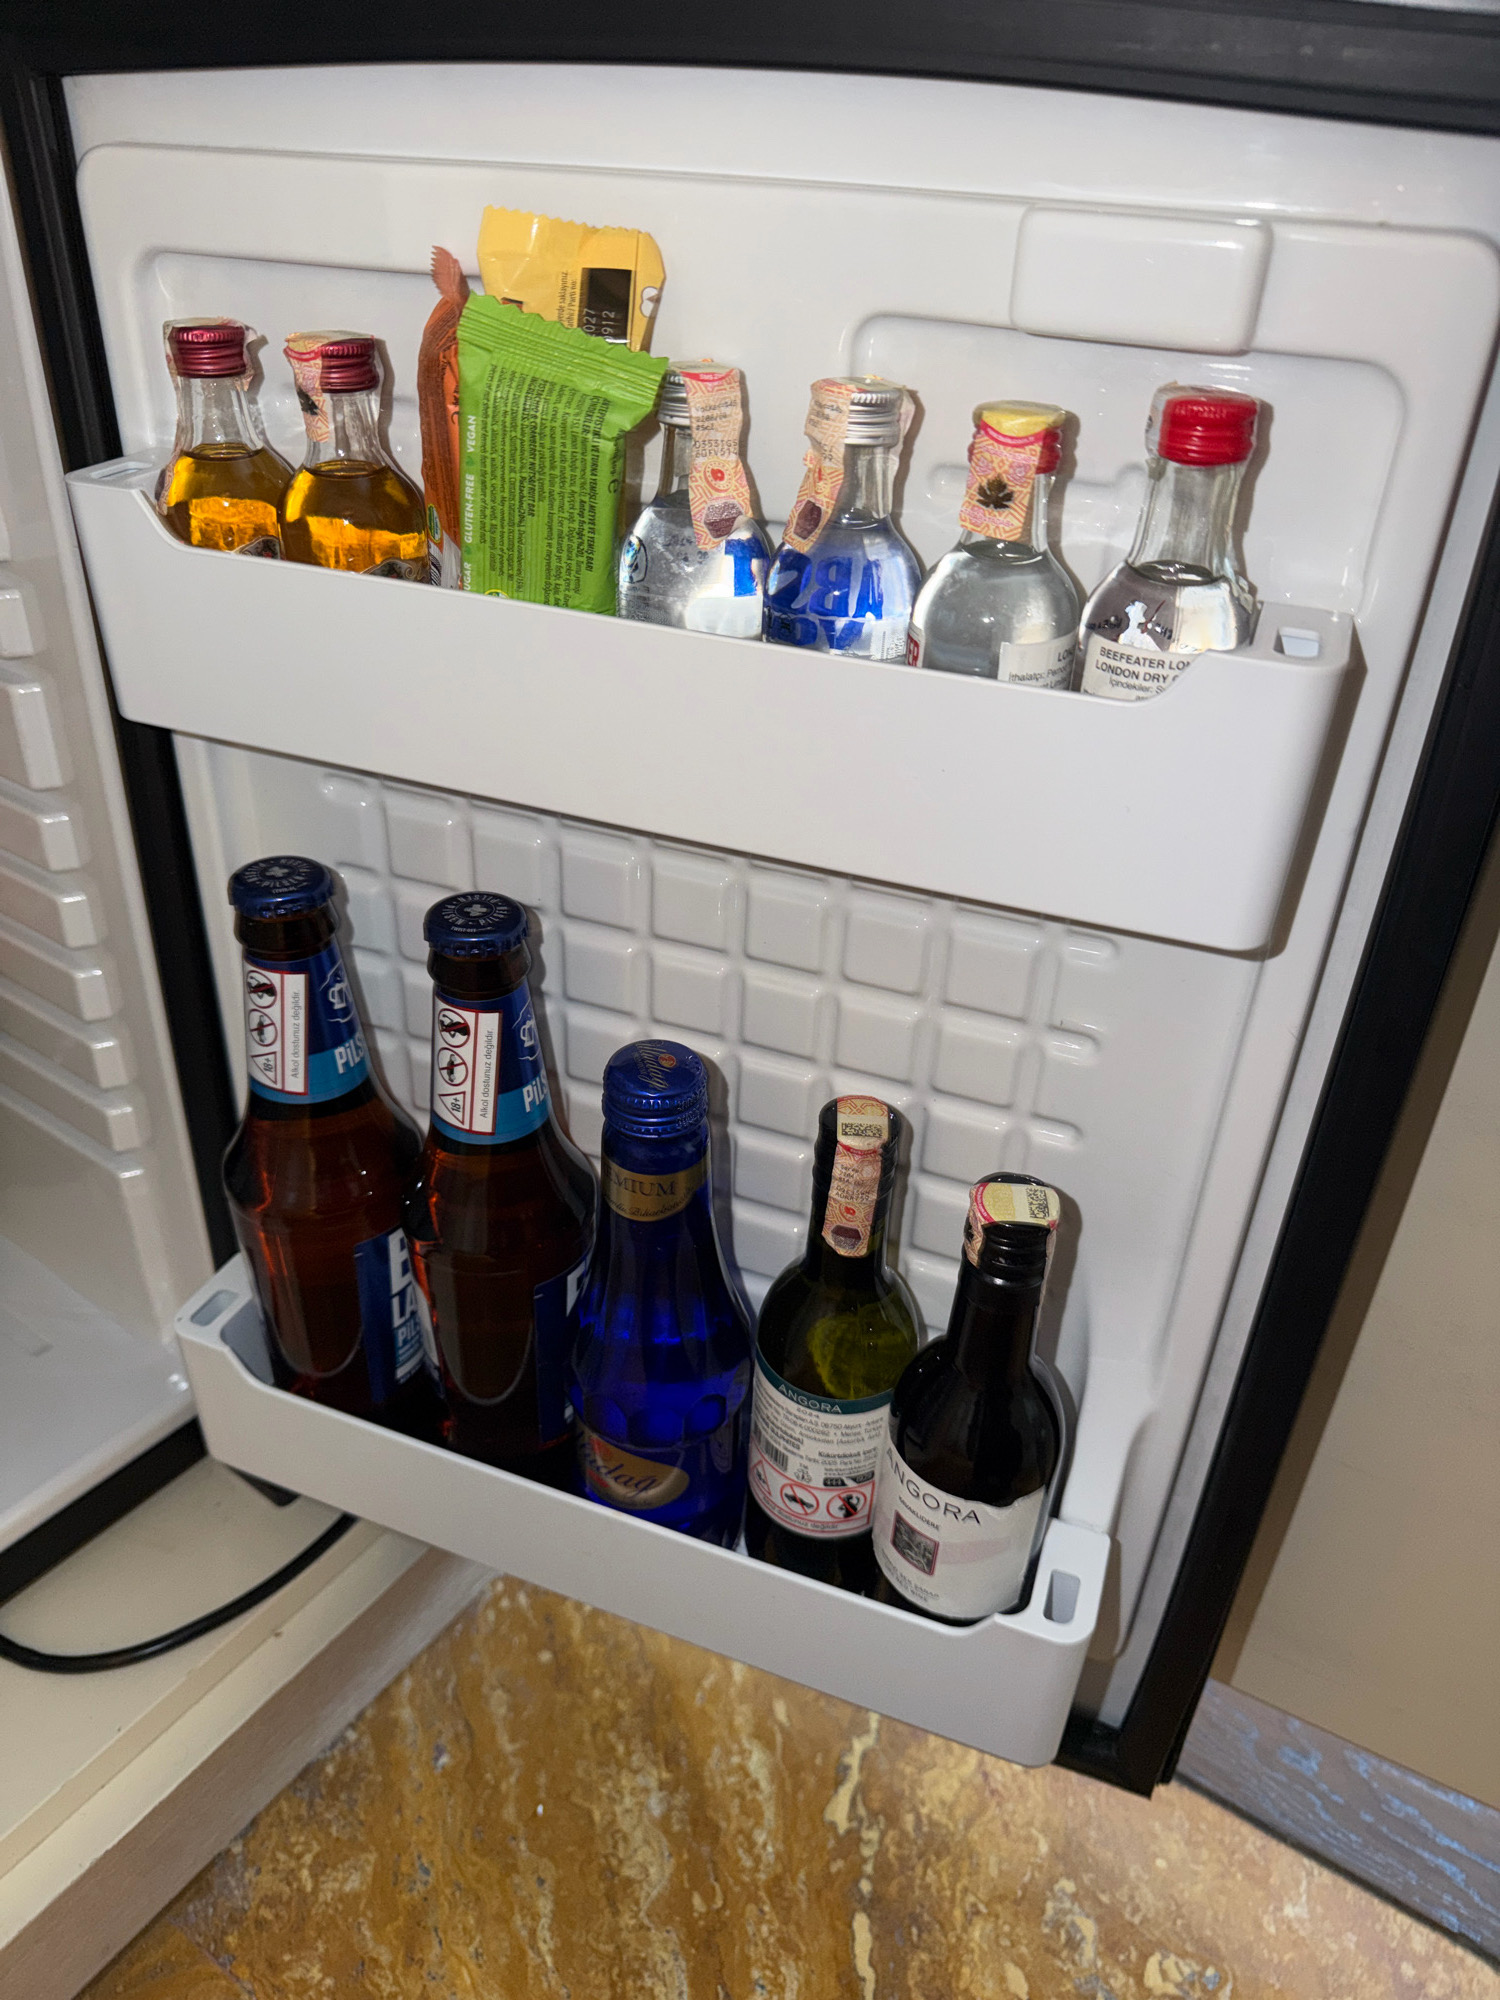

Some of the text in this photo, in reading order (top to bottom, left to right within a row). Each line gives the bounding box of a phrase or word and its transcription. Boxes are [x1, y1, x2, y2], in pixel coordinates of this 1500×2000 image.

[583, 308, 595, 337] 027
[467, 415, 477, 453] VEGAN
[589, 453, 599, 476] TURNA
[464, 473, 475, 544] GLUTEN-FREE
[587, 503, 597, 525] MEYVE
[585, 555, 594, 572] BARI
[1099, 646, 1166, 670] BEEFEATER
[1095, 659, 1169, 684] LONDON DRY
[457, 894, 501, 904] PILSEN
[291, 1022, 301, 1059] dostunuz
[262, 1057, 274, 1073] 18+
[290, 1059, 299, 1079] Alkol
[481, 1060, 492, 1098] dostunuz
[451, 1097, 462, 1113] 18+
[480, 1098, 488, 1119] Alkol
[778, 1383, 843, 1414] ANGORA
[886, 1446, 982, 1527] ANGORA
[899, 1495, 940, 1531] KAVAKLIDERE
